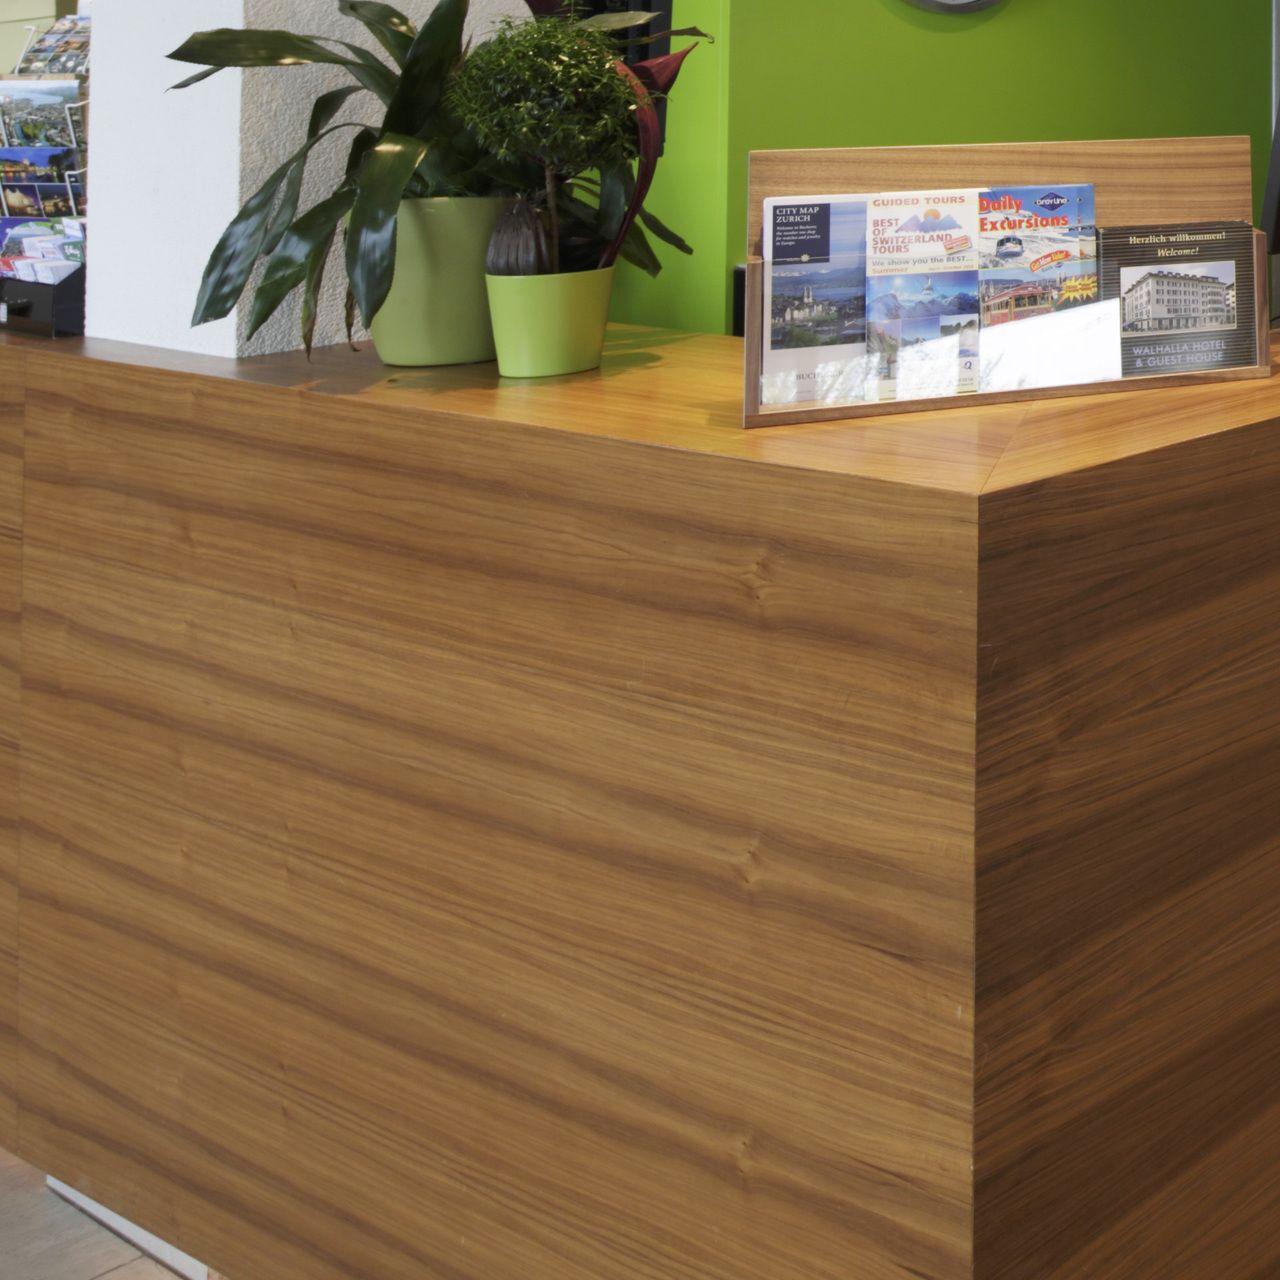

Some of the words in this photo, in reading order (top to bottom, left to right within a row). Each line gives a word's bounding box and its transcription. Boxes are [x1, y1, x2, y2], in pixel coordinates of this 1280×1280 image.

[873, 198, 920, 207] GUIDED
[924, 195, 966, 205] TOURS
[978, 194, 1022, 213] Daily
[776, 207, 798, 215] CITY
[799, 206, 820, 214] MAP
[776, 215, 810, 223] ZURICH
[872, 218, 900, 228] BEST
[979, 213, 1069, 232] Excursions
[872, 227, 887, 237] OF
[872, 233, 952, 246] SWITZERLAND
[1129, 235, 1165, 245] Herzlich
[1166, 232, 1226, 243] willkommen!
[872, 244, 909, 254] TOURS
[1157, 247, 1199, 257] Welcome!
[887, 258, 909, 266] show
[912, 258, 928, 266] you
[930, 256, 944, 264] the
[1132, 344, 1190, 355] WALHALLA
[1192, 340, 1227, 351] HOTEL
[1135, 358, 1143, 368] &
[1147, 355, 1184, 367] GUEST
[1186, 352, 1224, 363] HOUSE
